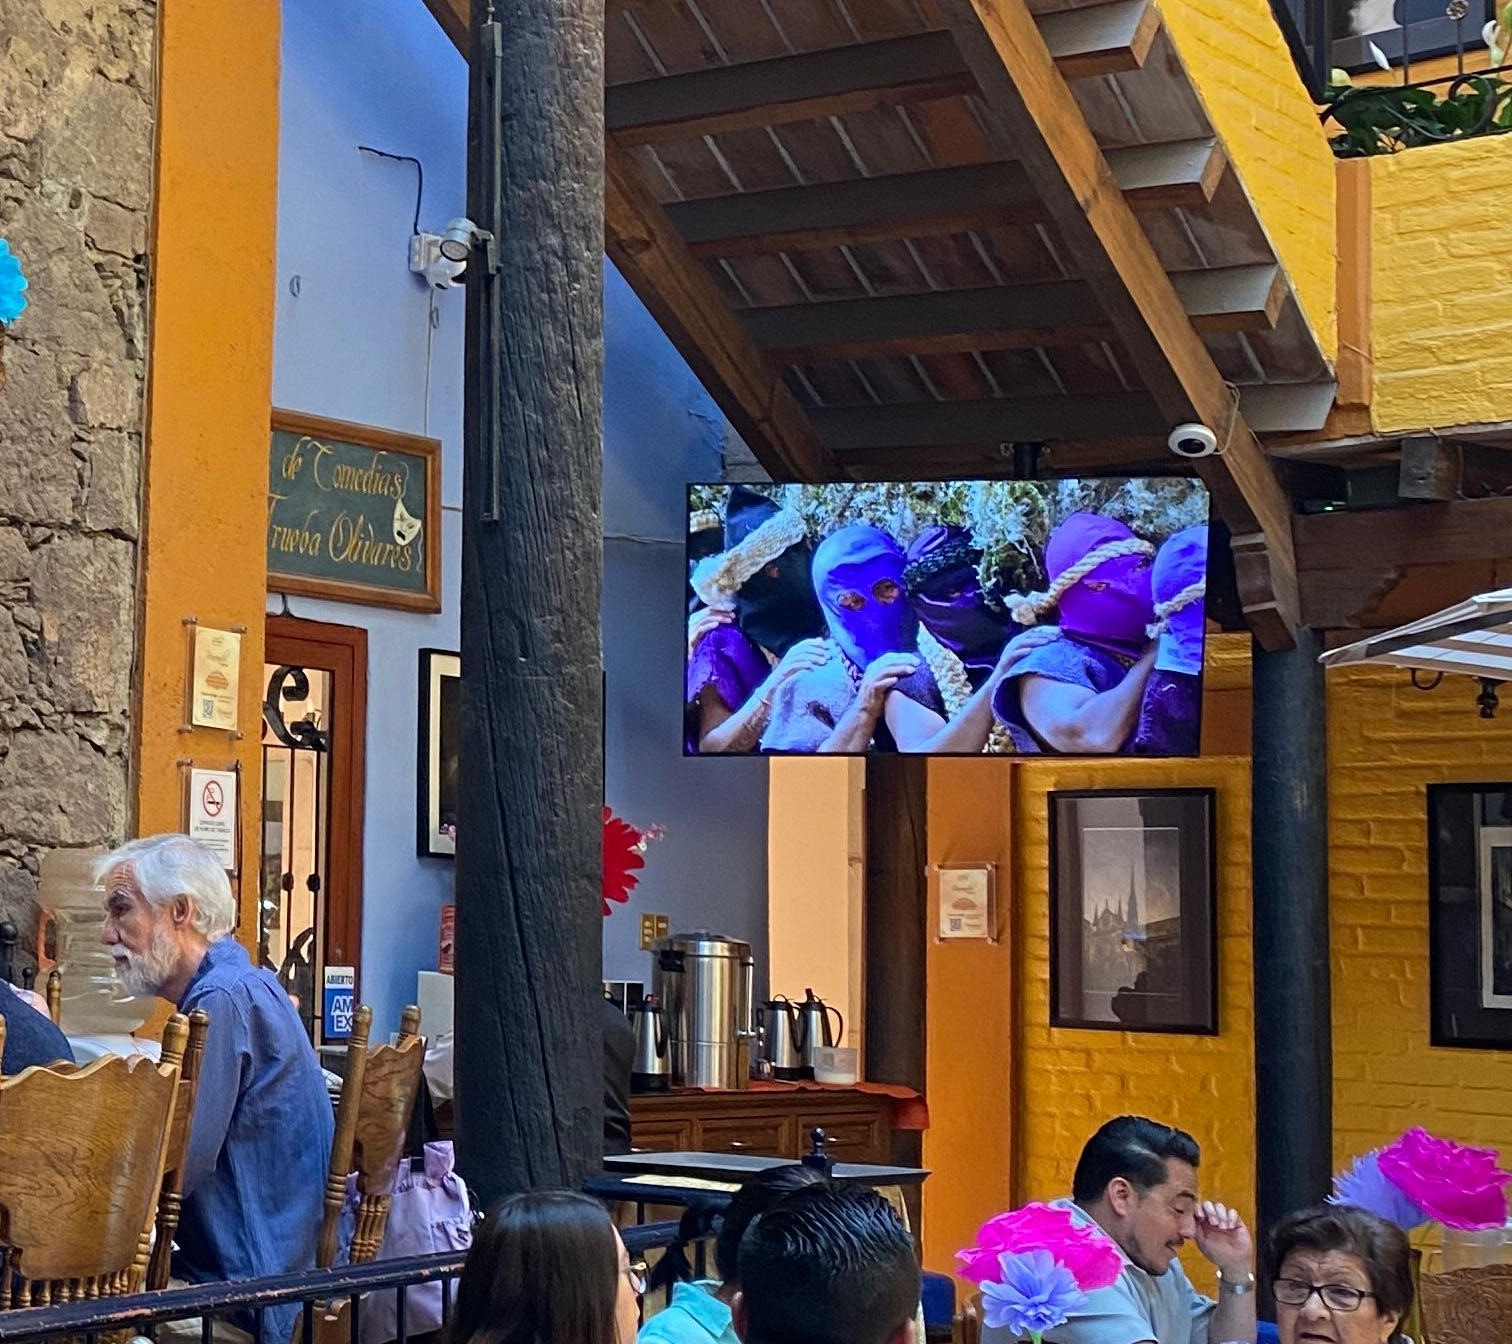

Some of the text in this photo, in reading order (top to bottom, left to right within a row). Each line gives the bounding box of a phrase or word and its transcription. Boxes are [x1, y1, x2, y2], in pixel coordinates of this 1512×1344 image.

[282, 436, 404, 500] de Comedias
[329, 509, 412, 572] Olivares
[326, 974, 354, 986] ABIERTO
[331, 995, 354, 1017] AM
[333, 1013, 354, 1032] EX
